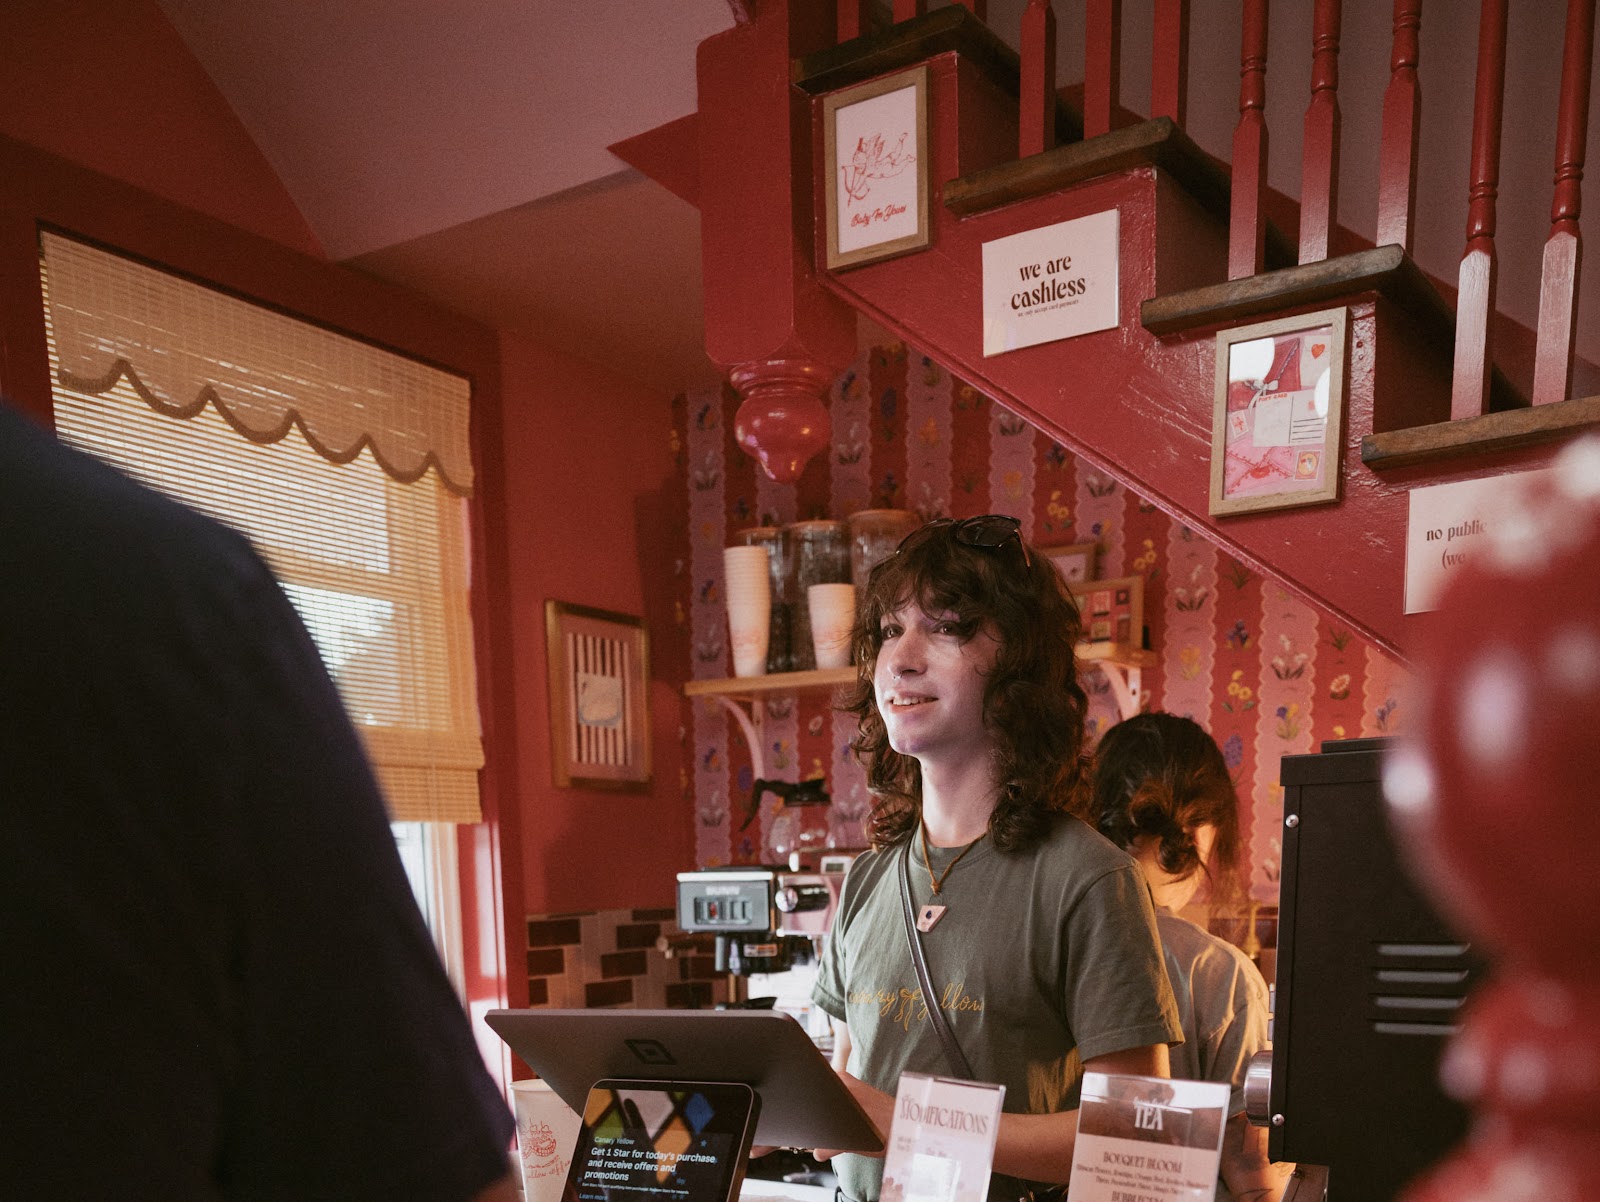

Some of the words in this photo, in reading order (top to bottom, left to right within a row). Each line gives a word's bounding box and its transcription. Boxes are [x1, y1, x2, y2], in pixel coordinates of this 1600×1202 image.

[1019, 263, 1041, 281] we
[1046, 255, 1071, 275] are
[1011, 277, 1086, 310] cashless
[1426, 529, 1443, 541] no
[1134, 1105, 1164, 1131] TEA
[594, 1136, 614, 1145] Canary
[591, 1147, 605, 1156] Get
[606, 1148, 612, 1156] 1
[613, 1149, 630, 1158] Star
[631, 1150, 644, 1159] for
[646, 1151, 675, 1161] today's
[676, 1153, 716, 1164] purchase
[1103, 1152, 1145, 1169] BOUQUET
[1146, 1157, 1182, 1173] BLOOM
[588, 1159, 603, 1168] and
[604, 1160, 632, 1170] receive
[634, 1162, 658, 1172] offers
[660, 1164, 677, 1173] and
[584, 1170, 629, 1181] promotions
